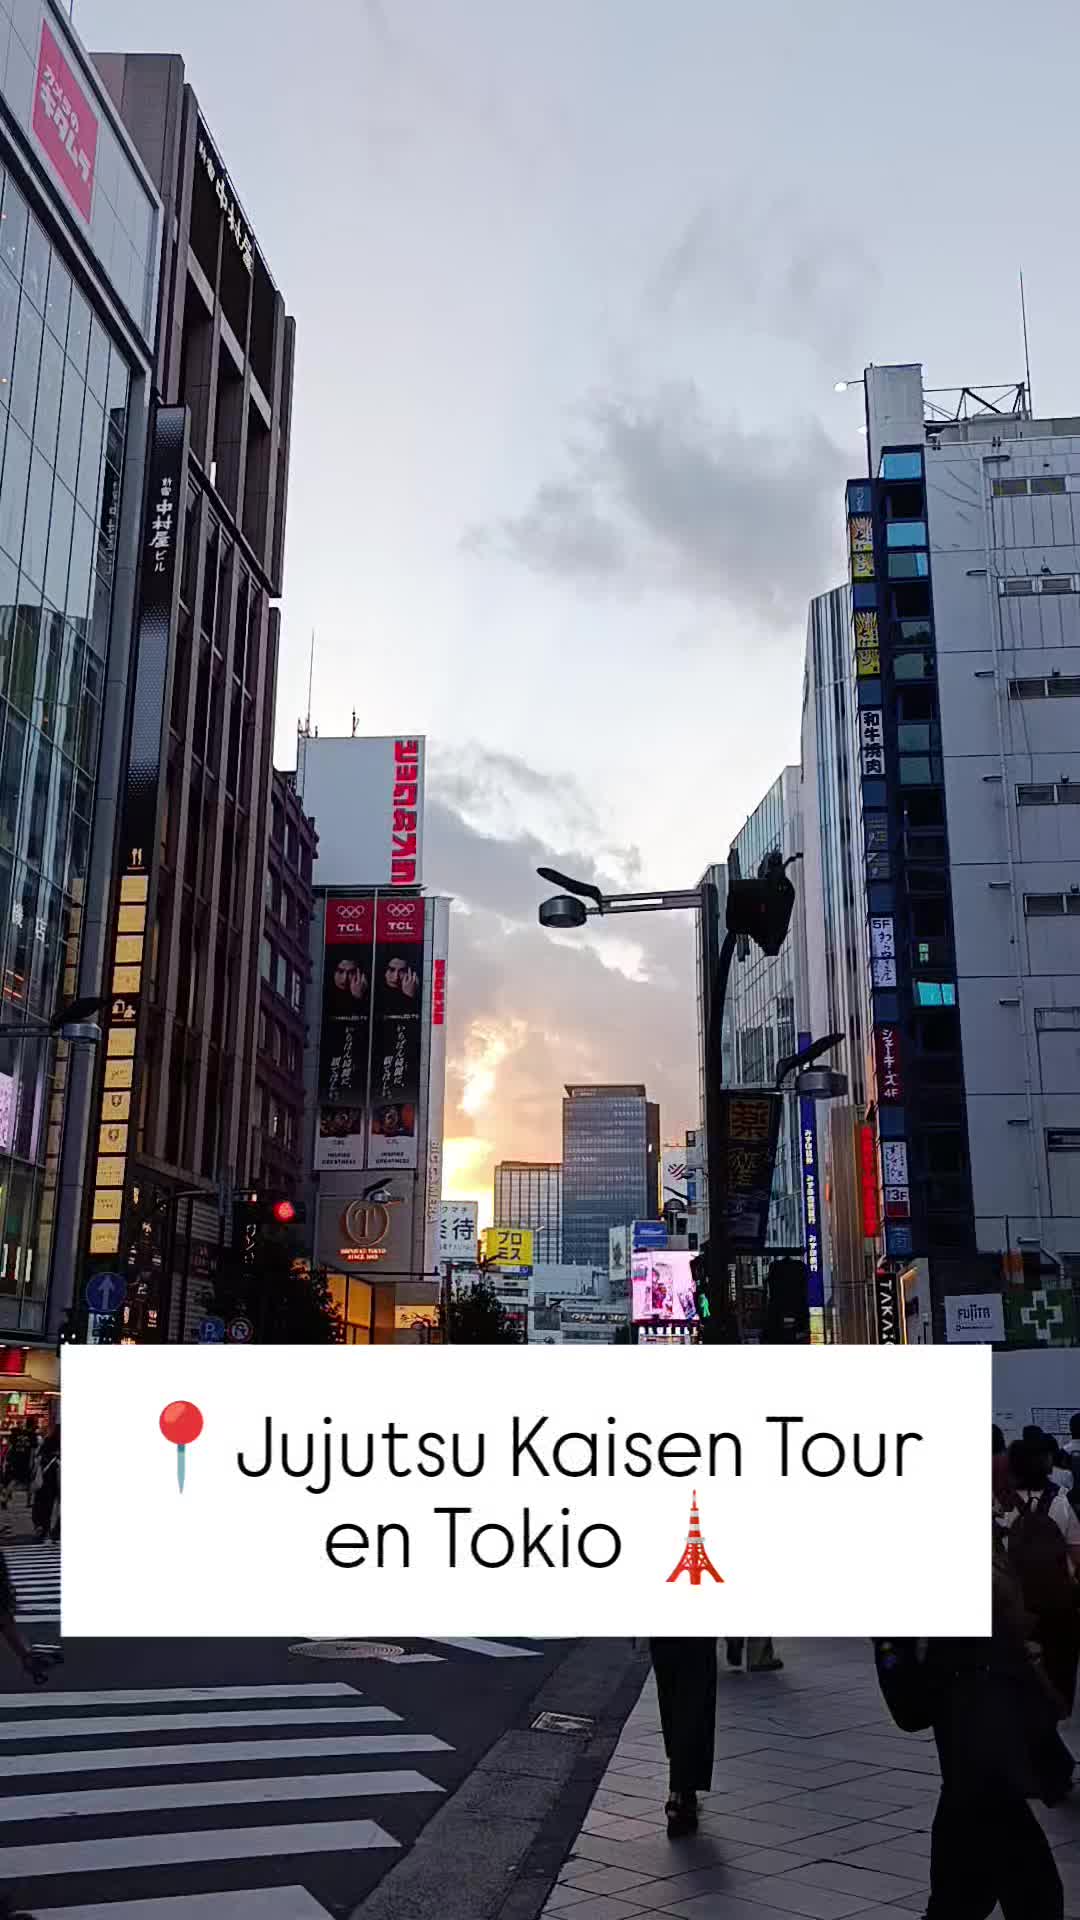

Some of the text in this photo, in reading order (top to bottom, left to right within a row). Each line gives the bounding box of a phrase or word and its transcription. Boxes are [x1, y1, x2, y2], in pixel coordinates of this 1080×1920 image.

[40, 82, 91, 182] キタムラ
[863, 711, 881, 774] 和牛焼肉
[338, 923, 363, 932] TCL
[388, 921, 414, 930] TCL
[872, 919, 892, 929] 5F
[497, 1231, 522, 1246] プロ
[497, 1247, 522, 1260] ミス
